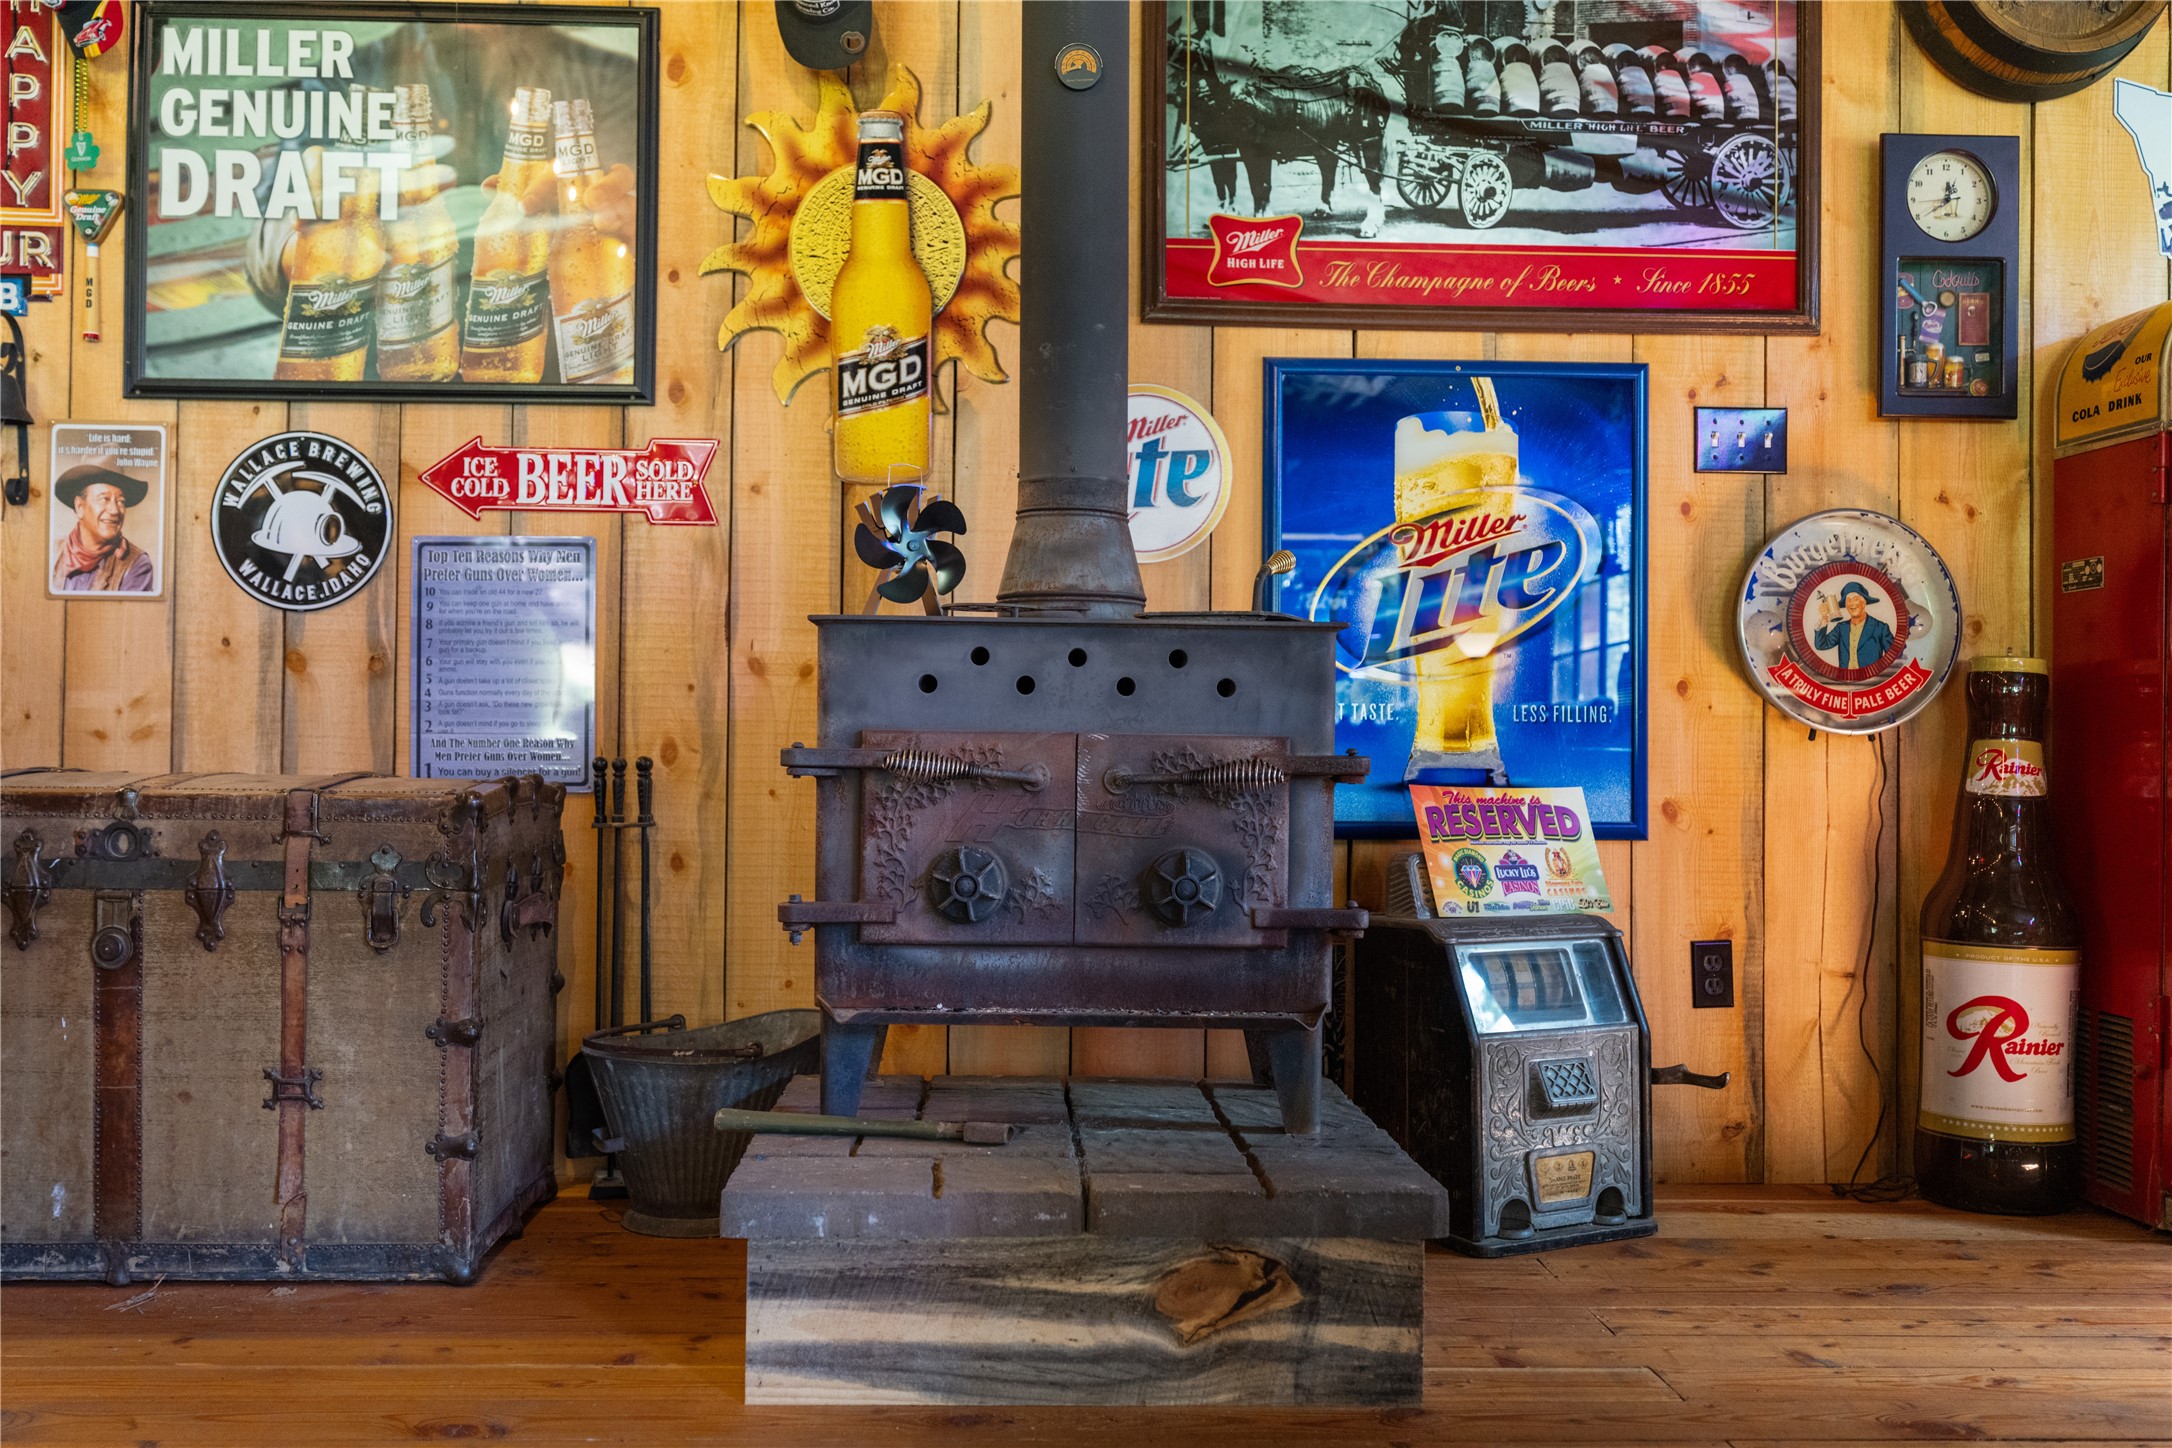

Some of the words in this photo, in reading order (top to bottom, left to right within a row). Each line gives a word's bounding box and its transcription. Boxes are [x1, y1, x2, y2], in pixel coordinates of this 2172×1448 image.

[162, 26, 354, 79] MILLER
[1, 0, 47, 207] APPY
[160, 87, 397, 140] GENUINE
[1529, 120, 1582, 130] MILLER
[1649, 125, 1685, 134] BEER
[508, 131, 545, 148] MGD
[558, 143, 595, 157] MGD
[159, 148, 412, 221] DRAFT
[857, 168, 904, 185] MGD
[69, 205, 107, 215] Genuine
[1976, 197, 1982, 205] 3
[75, 212, 101, 221] Draft
[1226, 228, 1285, 257] Miller
[1319, 260, 1361, 289] The
[1366, 260, 1494, 298] Champagne
[1499, 264, 1535, 298] of
[1529, 264, 1597, 293] Beers
[1636, 266, 1692, 294] Since
[1697, 272, 1756, 295] 1855
[85, 277, 93, 308] MGD
[308, 289, 359, 311] Miller
[484, 282, 531, 305] Miller
[287, 320, 334, 331] GENUINE
[467, 313, 509, 324] GENUINE
[582, 342, 618, 362] LIGHT
[862, 338, 901, 359] Miller
[2134, 352, 2152, 365] OUR
[842, 354, 922, 399] MGD
[842, 391, 887, 407] GENUINE
[891, 380, 923, 396] DRAFT
[2072, 404, 2101, 423] COLA
[2108, 392, 2142, 413] DRINK
[103, 433, 111, 443] is
[462, 456, 499, 477] ICE
[635, 459, 696, 481] SOLD
[221, 440, 300, 508] WALLACE
[307, 441, 383, 515] BREWING
[515, 452, 631, 506] BEER
[450, 476, 511, 498] COLD
[635, 480, 694, 501] HERE
[1389, 513, 1528, 568] Miller
[427, 549, 448, 565] Top
[452, 549, 473, 564] Ten
[476, 549, 525, 564] Reasons
[528, 549, 554, 566] Why
[556, 549, 581, 564] Men
[323, 553, 372, 598] IDAHO
[423, 568, 461, 582] Prefer
[464, 568, 493, 582] Guns
[497, 567, 524, 582] Over
[425, 586, 436, 597] 10
[426, 601, 434, 611] 9
[1350, 540, 1567, 668] Lite
[425, 619, 433, 630] 8
[425, 638, 433, 649] 7
[425, 656, 433, 666] 6
[425, 673, 432, 684] 5
[424, 688, 431, 697] 4
[1781, 669, 1791, 680] A
[1788, 673, 1824, 703] TRULY
[1821, 693, 1848, 710] FINE
[1854, 693, 1885, 710] PALE
[1884, 671, 1917, 701] BEER
[424, 701, 431, 712] 3
[1352, 702, 1400, 721] TASTE.
[1513, 704, 1547, 723] LESS
[1552, 703, 1613, 724] FILLING.
[424, 720, 433, 733] 2
[431, 738, 447, 748] And
[448, 738, 465, 748] The
[467, 738, 501, 748] Number
[503, 738, 521, 748] One
[522, 738, 554, 748] Reason
[555, 737, 575, 749] Why
[434, 752, 452, 761] Men
[454, 752, 481, 761] Prefer
[483, 752, 505, 761] Guns
[507, 752, 527, 761] Over
[1975, 748, 2043, 782] Rainier
[424, 762, 431, 778] 1
[438, 767, 455, 776] You
[456, 768, 473, 776] can
[475, 767, 491, 778] buy
[501, 767, 537, 776] silencer
[560, 767, 581, 779] gun!
[1441, 790, 1472, 806] This
[1476, 792, 1526, 807] machine
[1529, 794, 1542, 806] is
[1424, 803, 1582, 842] RESERVED
[1496, 867, 1520, 878] LUCKY
[1456, 879, 1495, 899] CASINOS
[1502, 880, 1541, 897] CASINOS
[1965, 953, 2001, 961] PRODUCT
[1946, 995, 2065, 1083] Rainier
